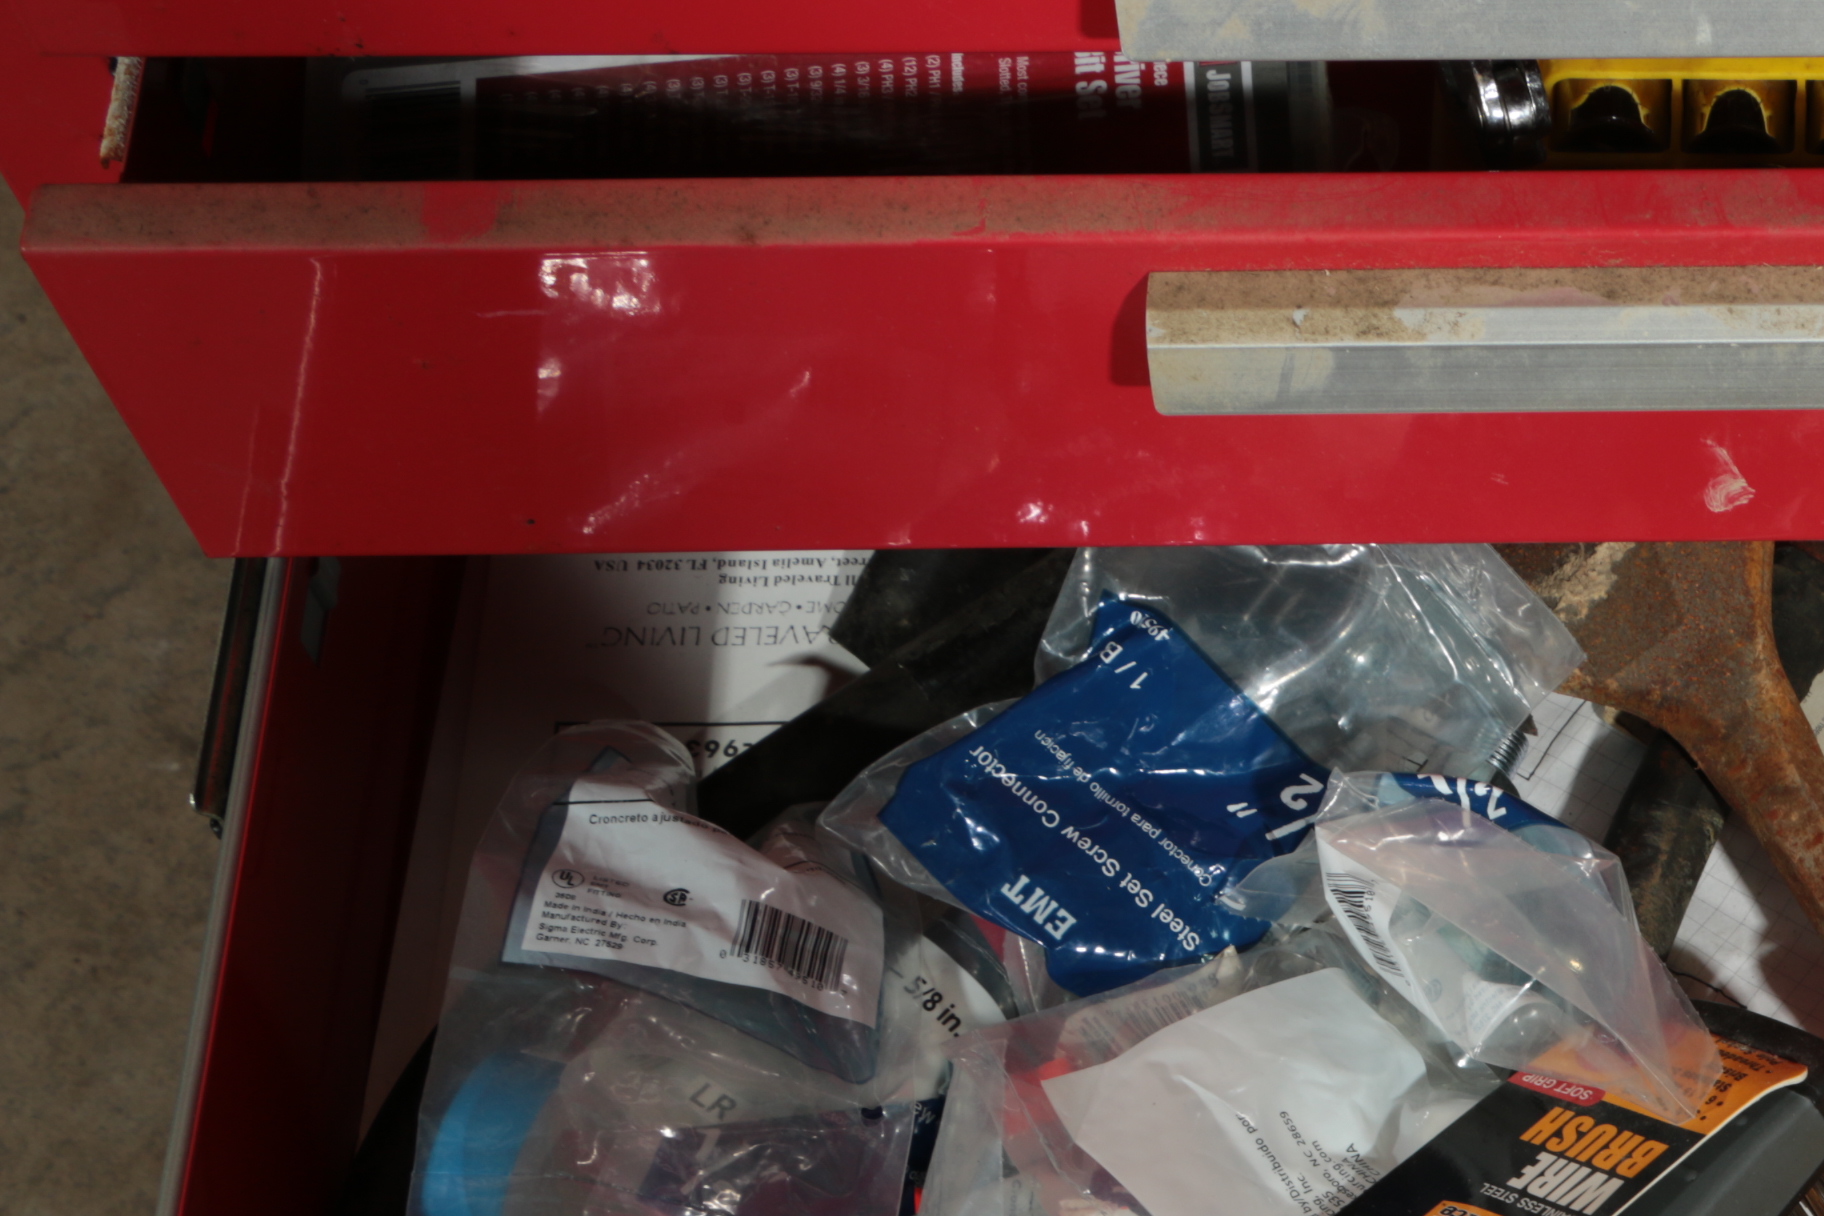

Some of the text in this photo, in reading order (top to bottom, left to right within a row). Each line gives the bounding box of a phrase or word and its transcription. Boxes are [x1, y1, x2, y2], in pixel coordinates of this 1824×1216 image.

[593, 559, 627, 571] USA
[636, 559, 682, 570] 32034
[686, 558, 707, 570] FL
[712, 557, 767, 570] Island,
[771, 557, 826, 568] Amelia
[717, 573, 839, 586] Traveled Living
[646, 601, 700, 614] PATIO
[716, 600, 791, 614] GARDEN
[1096, 636, 1124, 665] B
[1068, 762, 1092, 786] de
[1085, 777, 1131, 821] tornillo
[587, 812, 650, 825] Croncreto
[1126, 807, 1163, 843] para
[964, 739, 1204, 953] Steel Set Screw Connector
[1155, 833, 1216, 890] Conector
[543, 899, 569, 911] Made
[582, 904, 607, 916] India
[615, 910, 646, 923] Hecho
[649, 915, 662, 925] en
[663, 916, 687, 928] India
[999, 866, 1078, 942] EMT
[541, 909, 608, 927] Manufactured
[537, 921, 568, 936] Sigma
[569, 924, 606, 940] Electric
[573, 935, 590, 947] NC
[1520, 1070, 1594, 1099] SOFT GRIP
[1277, 1108, 1306, 1148] 28659
[1518, 1103, 1670, 1181] BRUSH
[1302, 1148, 1320, 1169] NC
[1253, 1135, 1313, 1214] by/Distribuido
[1293, 1171, 1313, 1195] Inc.
[1505, 1148, 1625, 1214] WIRE
[1478, 1181, 1519, 1203] STEEL
